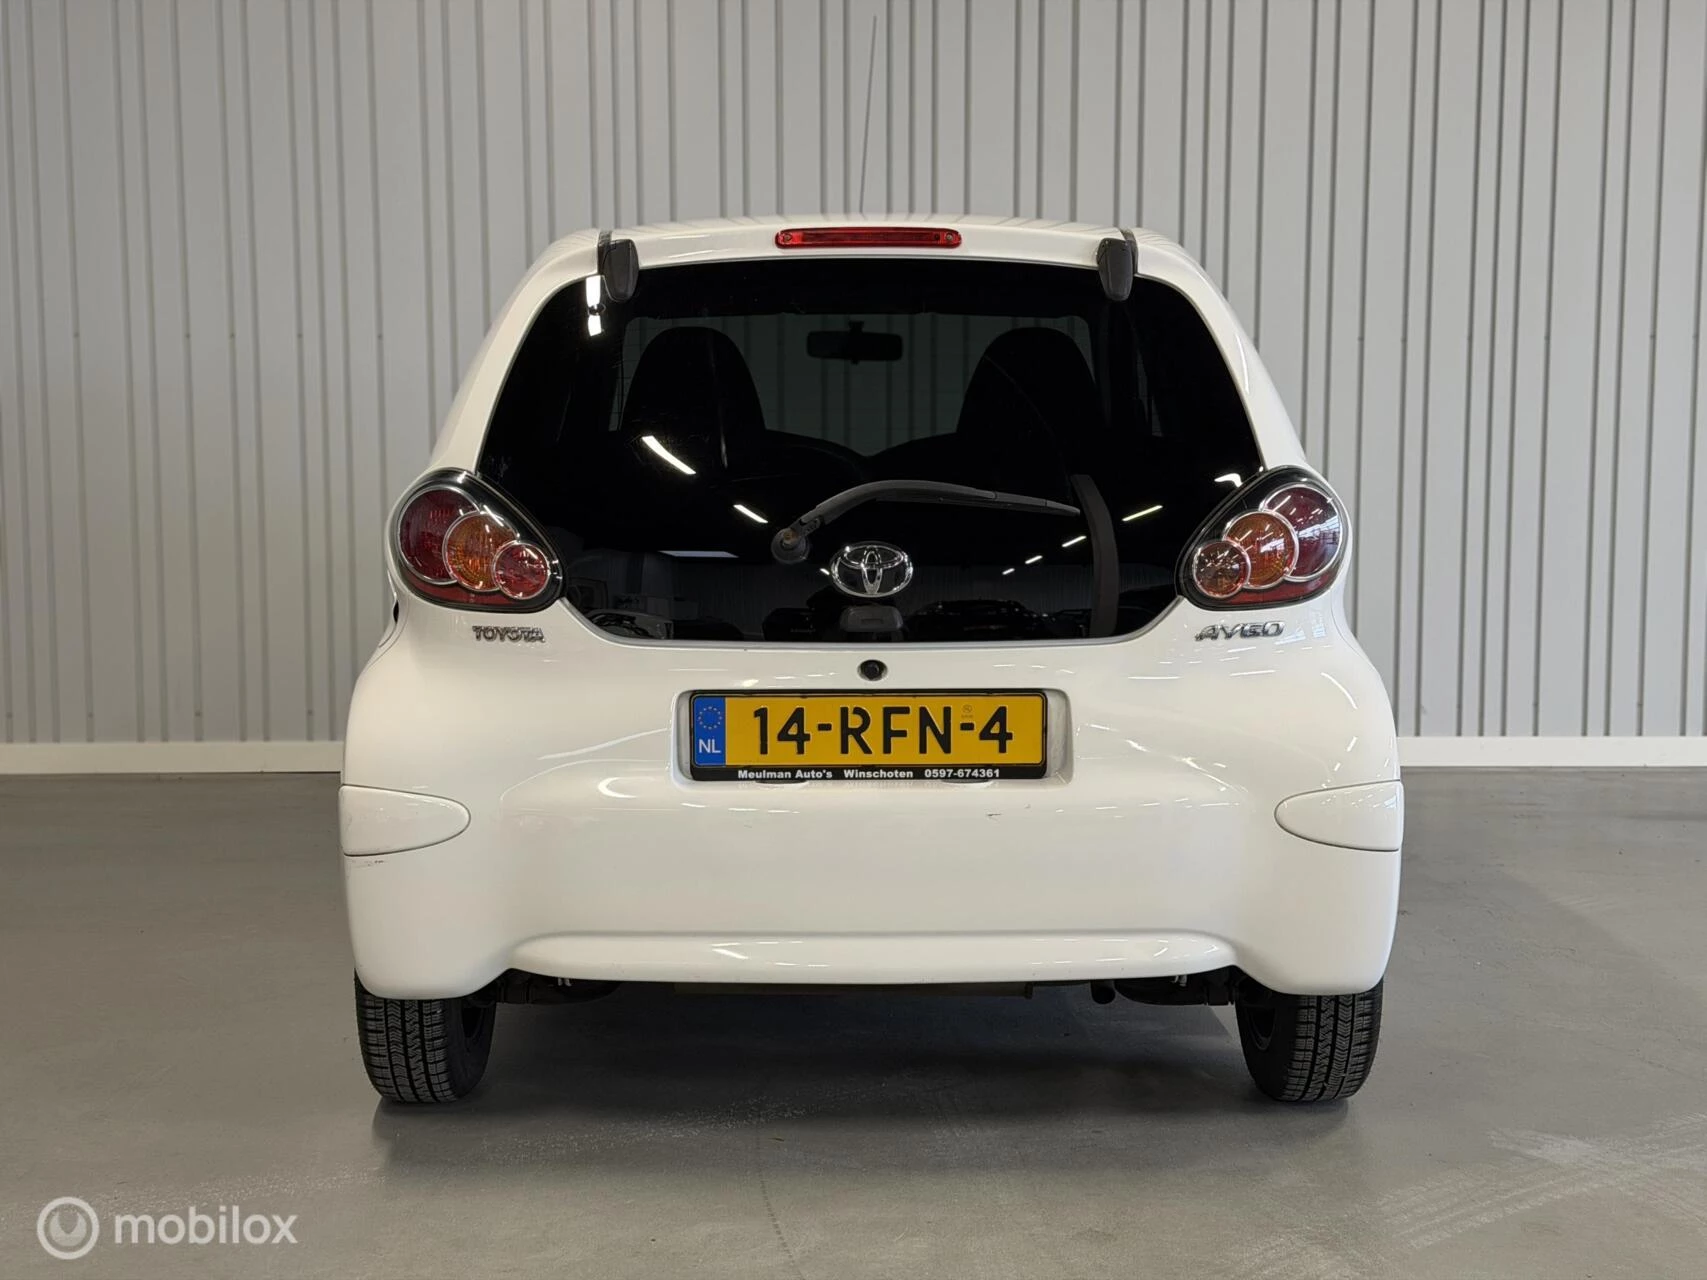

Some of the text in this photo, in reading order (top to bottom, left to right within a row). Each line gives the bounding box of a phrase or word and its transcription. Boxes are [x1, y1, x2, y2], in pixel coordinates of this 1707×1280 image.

[472, 625, 545, 643] TOYOTA
[1194, 621, 1285, 641] AYGO
[753, 706, 1013, 755] 14-RFN-4
[698, 739, 721, 754] NL
[737, 768, 1000, 779] Meulman Auto's Winschoten 0597-674361
